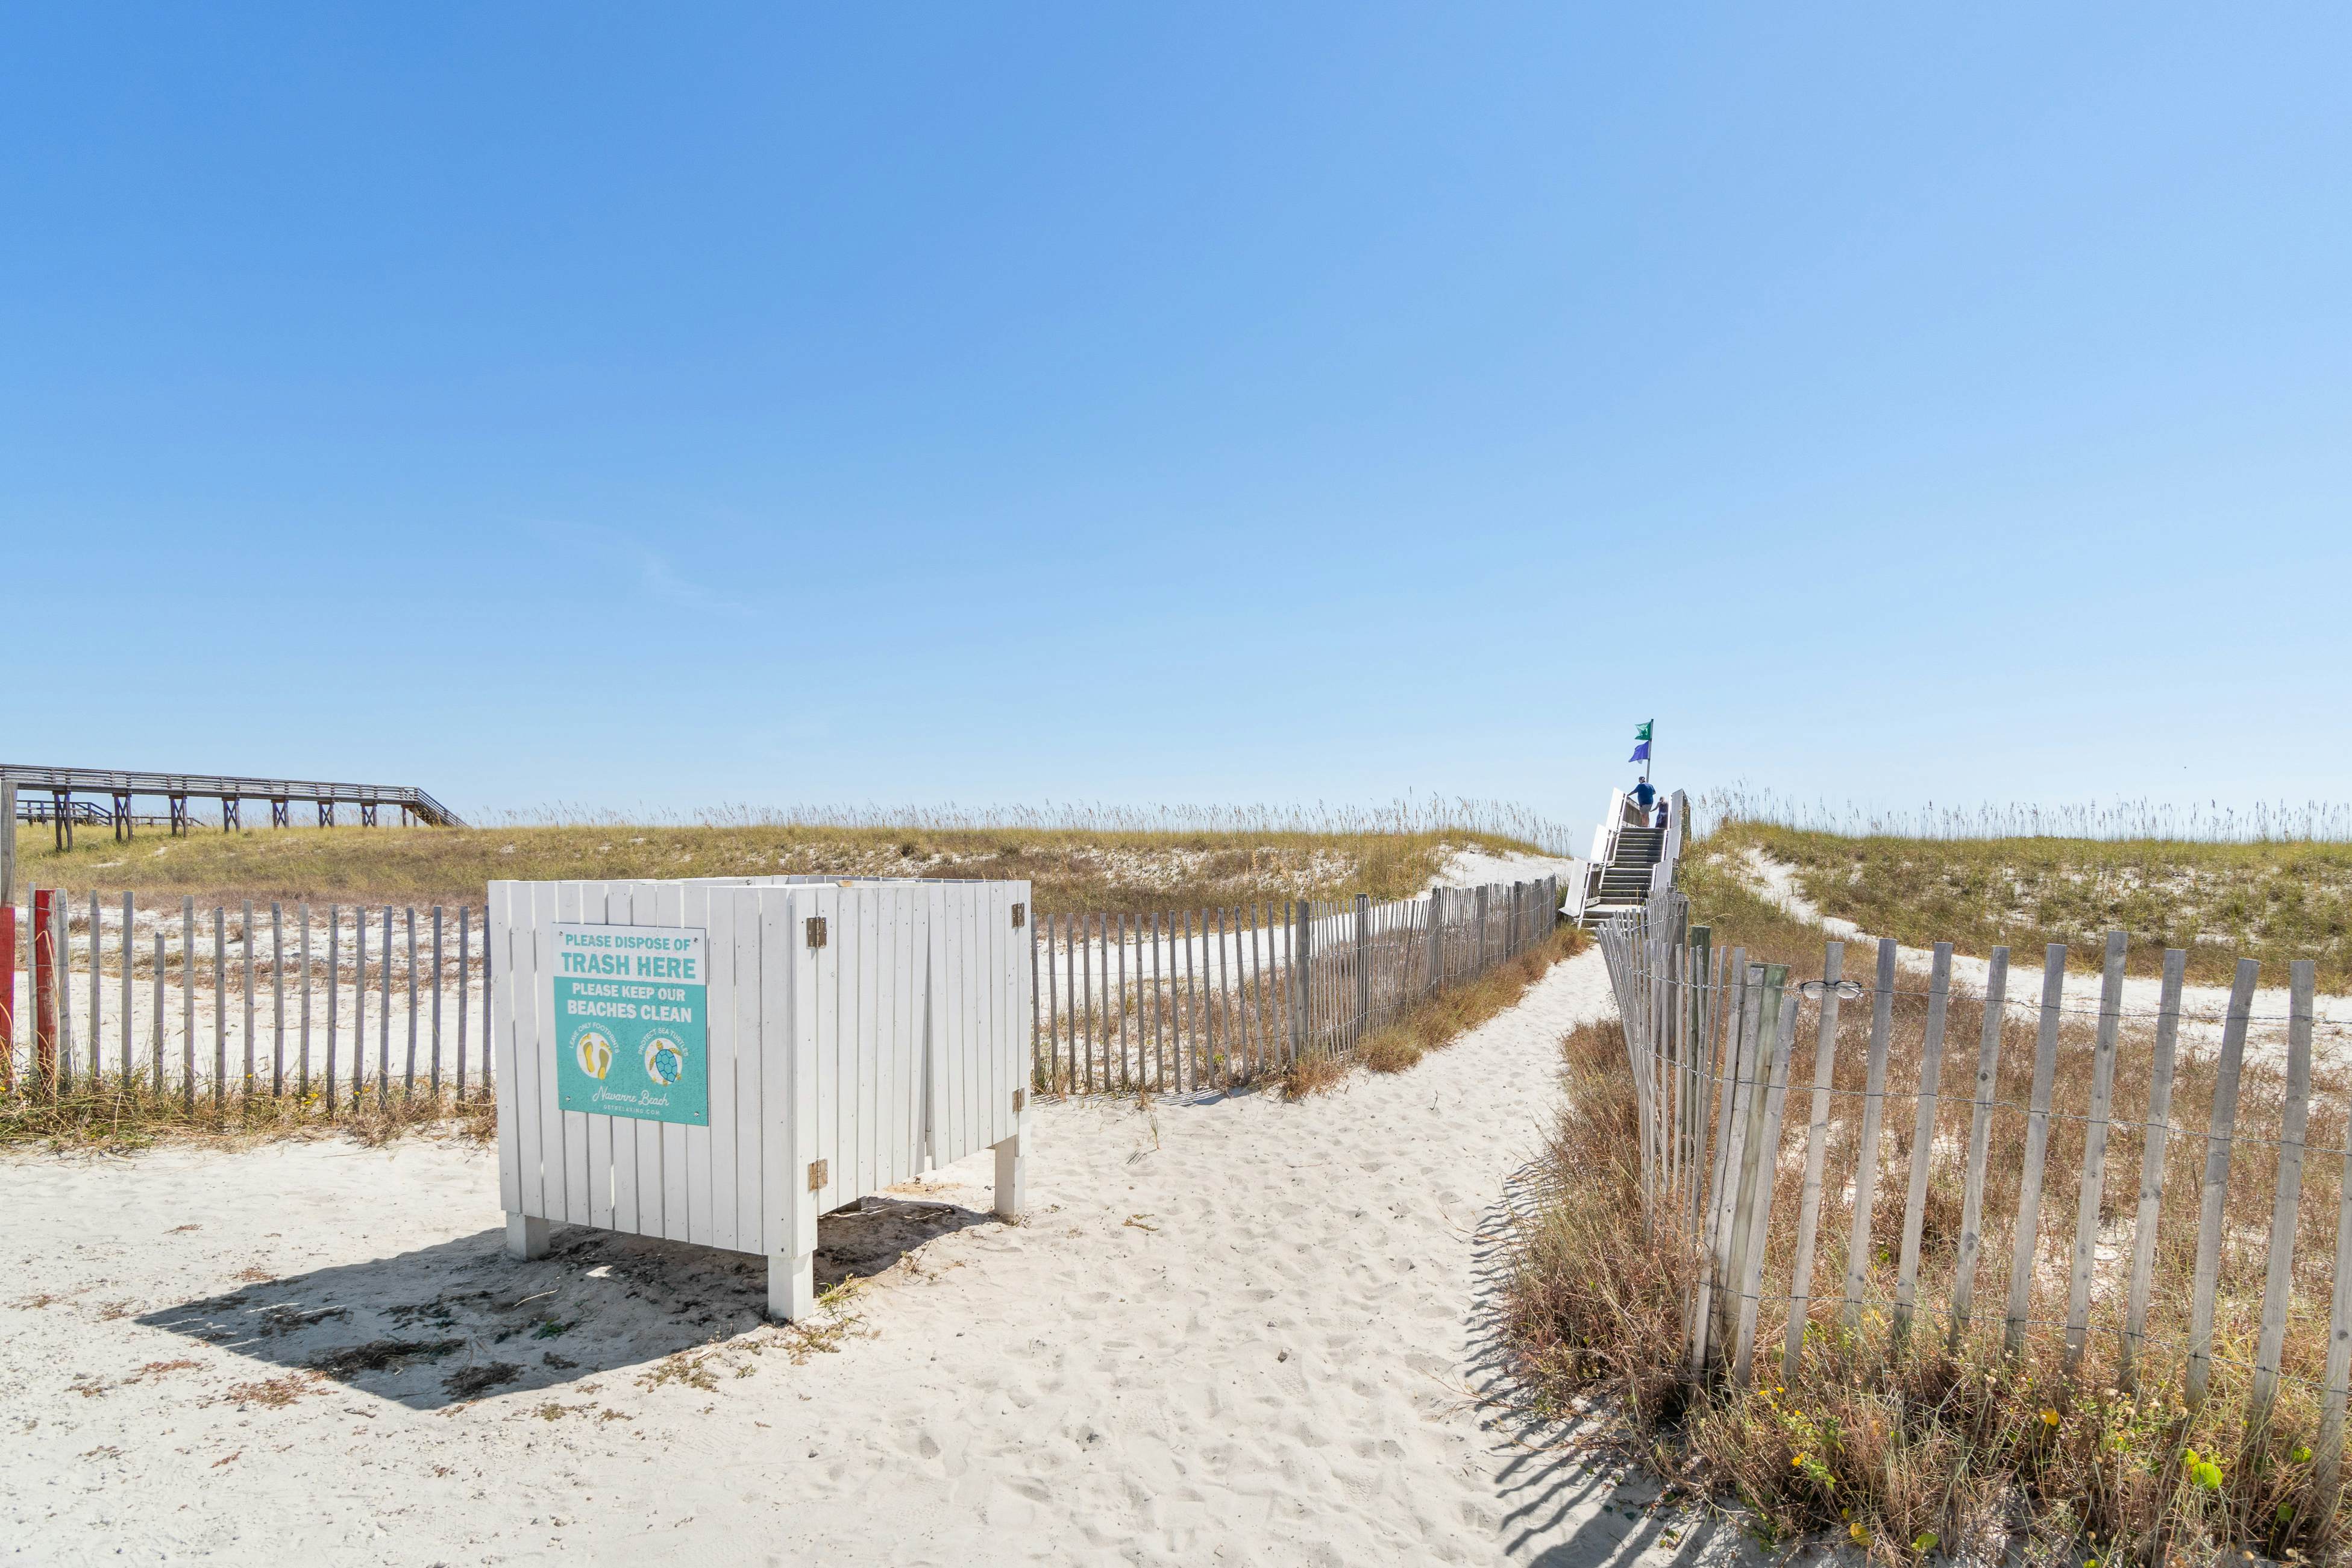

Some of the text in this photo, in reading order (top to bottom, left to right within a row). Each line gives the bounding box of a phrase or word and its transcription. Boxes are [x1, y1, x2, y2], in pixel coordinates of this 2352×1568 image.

[566, 934, 691, 951] PLEASE DISPOSE OF
[561, 952, 695, 979] TRASH HERE
[572, 982, 685, 1002] PLEASE KEEP OUR
[567, 1000, 692, 1023] BEACHES CLEAN
[568, 1021, 620, 1054] LEAVE ONLY FOOTPRINTS
[638, 1028, 656, 1055] PROTECT
[670, 1030, 689, 1057] TURTLES
[592, 1085, 670, 1106] Navarre Beach
